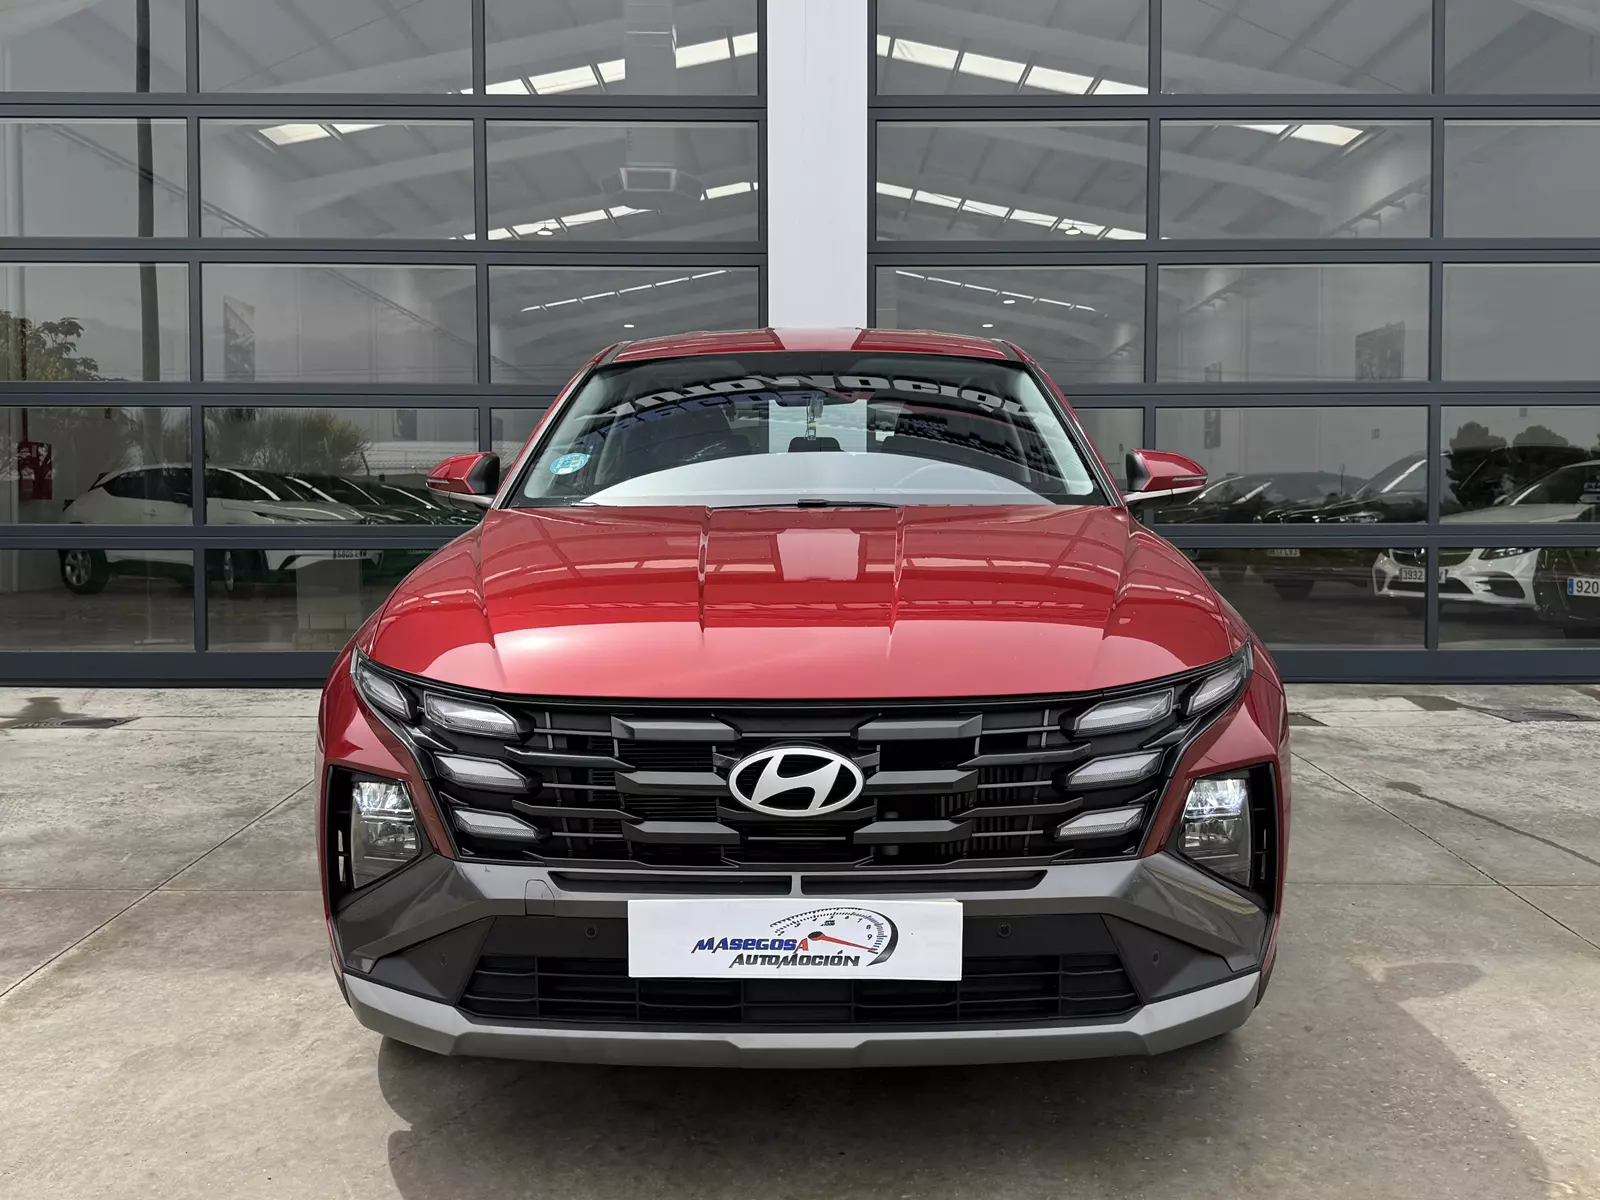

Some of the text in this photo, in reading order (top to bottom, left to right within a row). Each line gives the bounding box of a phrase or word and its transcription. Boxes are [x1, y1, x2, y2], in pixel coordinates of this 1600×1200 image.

[1403, 570, 1423, 580] 3932
[1576, 577, 1599, 594] 920
[728, 950, 860, 969] AUTOMOCIÓN
